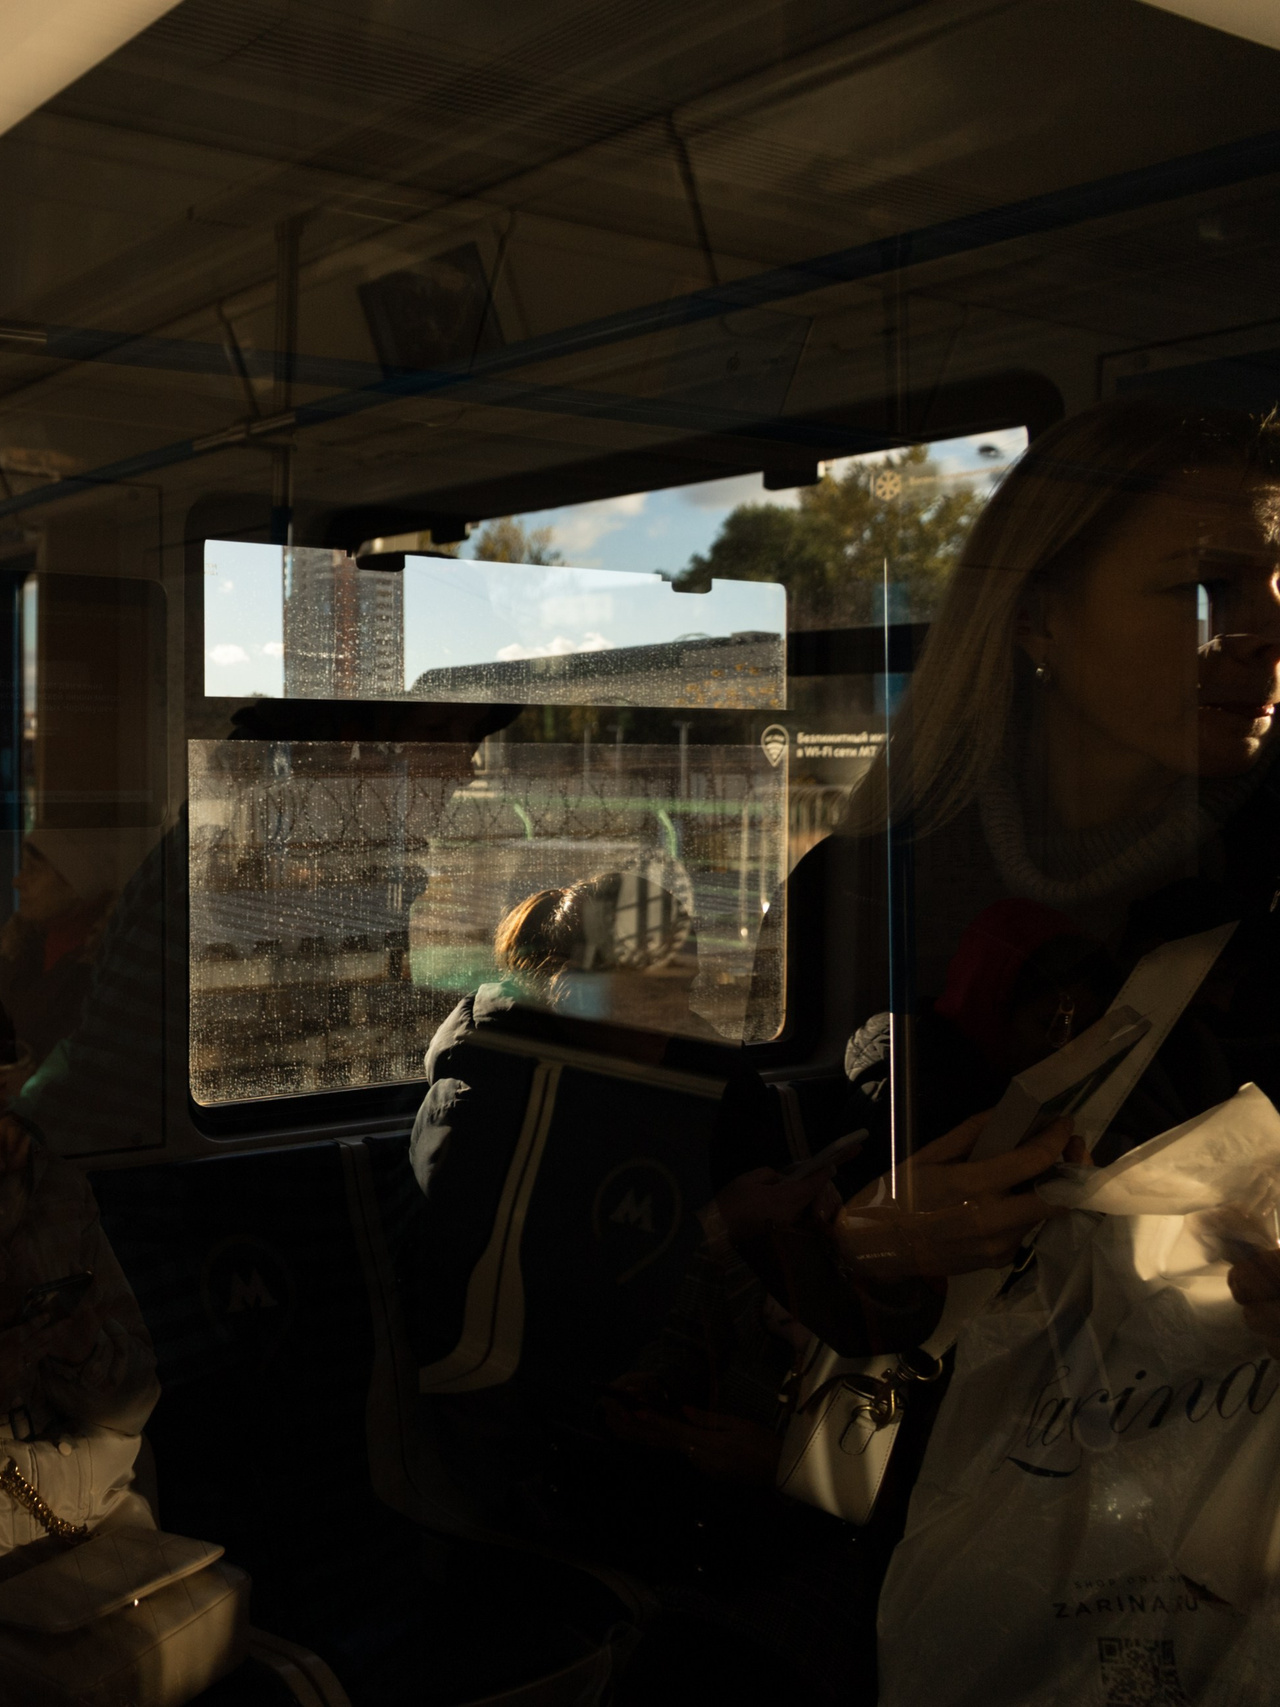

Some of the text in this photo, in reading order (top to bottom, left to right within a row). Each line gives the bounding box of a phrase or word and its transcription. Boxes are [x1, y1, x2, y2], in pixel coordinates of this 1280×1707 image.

[797, 731, 868, 744] Безлимитный
[804, 745, 832, 758] Wi-Fi
[833, 747, 858, 758] сети
